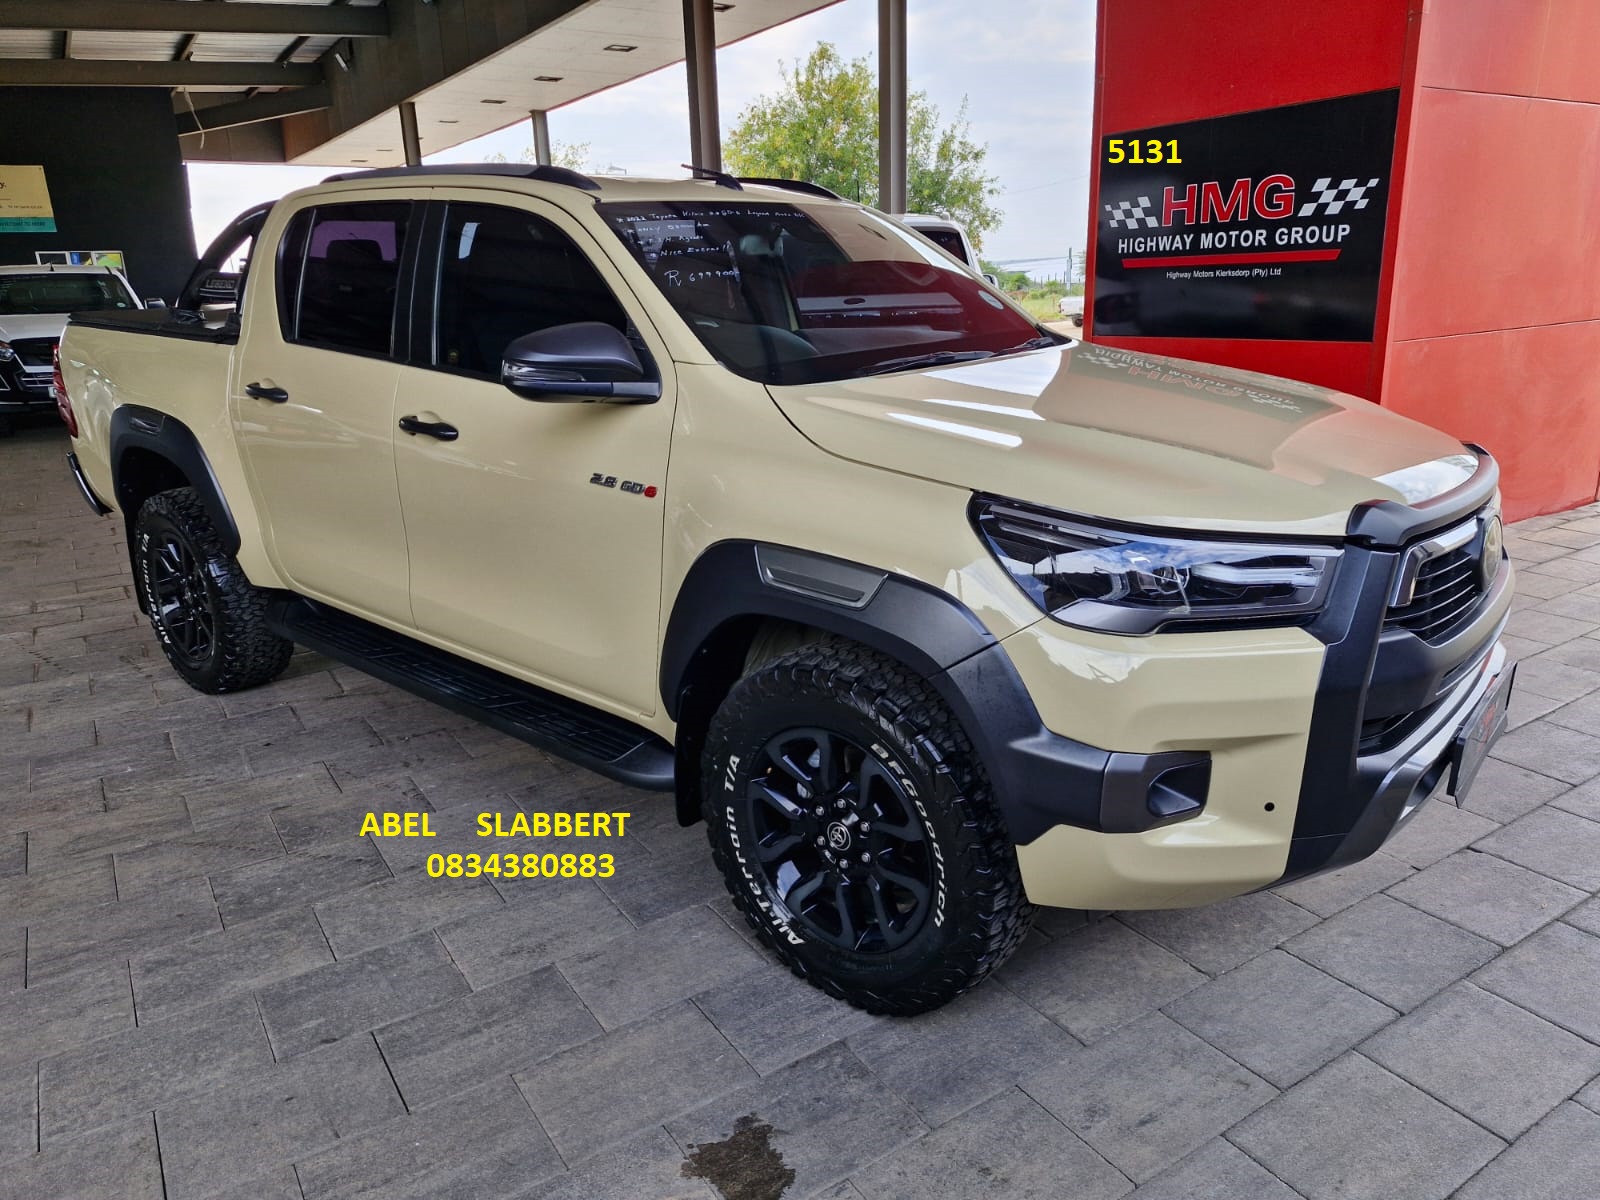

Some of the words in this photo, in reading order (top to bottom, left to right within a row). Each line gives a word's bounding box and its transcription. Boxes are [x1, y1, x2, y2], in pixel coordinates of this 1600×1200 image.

[1161, 173, 1296, 228] HMG
[1118, 233, 1194, 254] HIGHWAY
[1200, 229, 1267, 249] MOTOR
[1275, 224, 1351, 246] GROUP
[1166, 271, 1192, 280] Highway
[1193, 270, 1214, 278] Motors
[1215, 269, 1250, 278] Klerksdorp
[1251, 268, 1268, 278] (Pty)
[1269, 267, 1282, 276] Ltd
[724, 753, 741, 793] T/A
